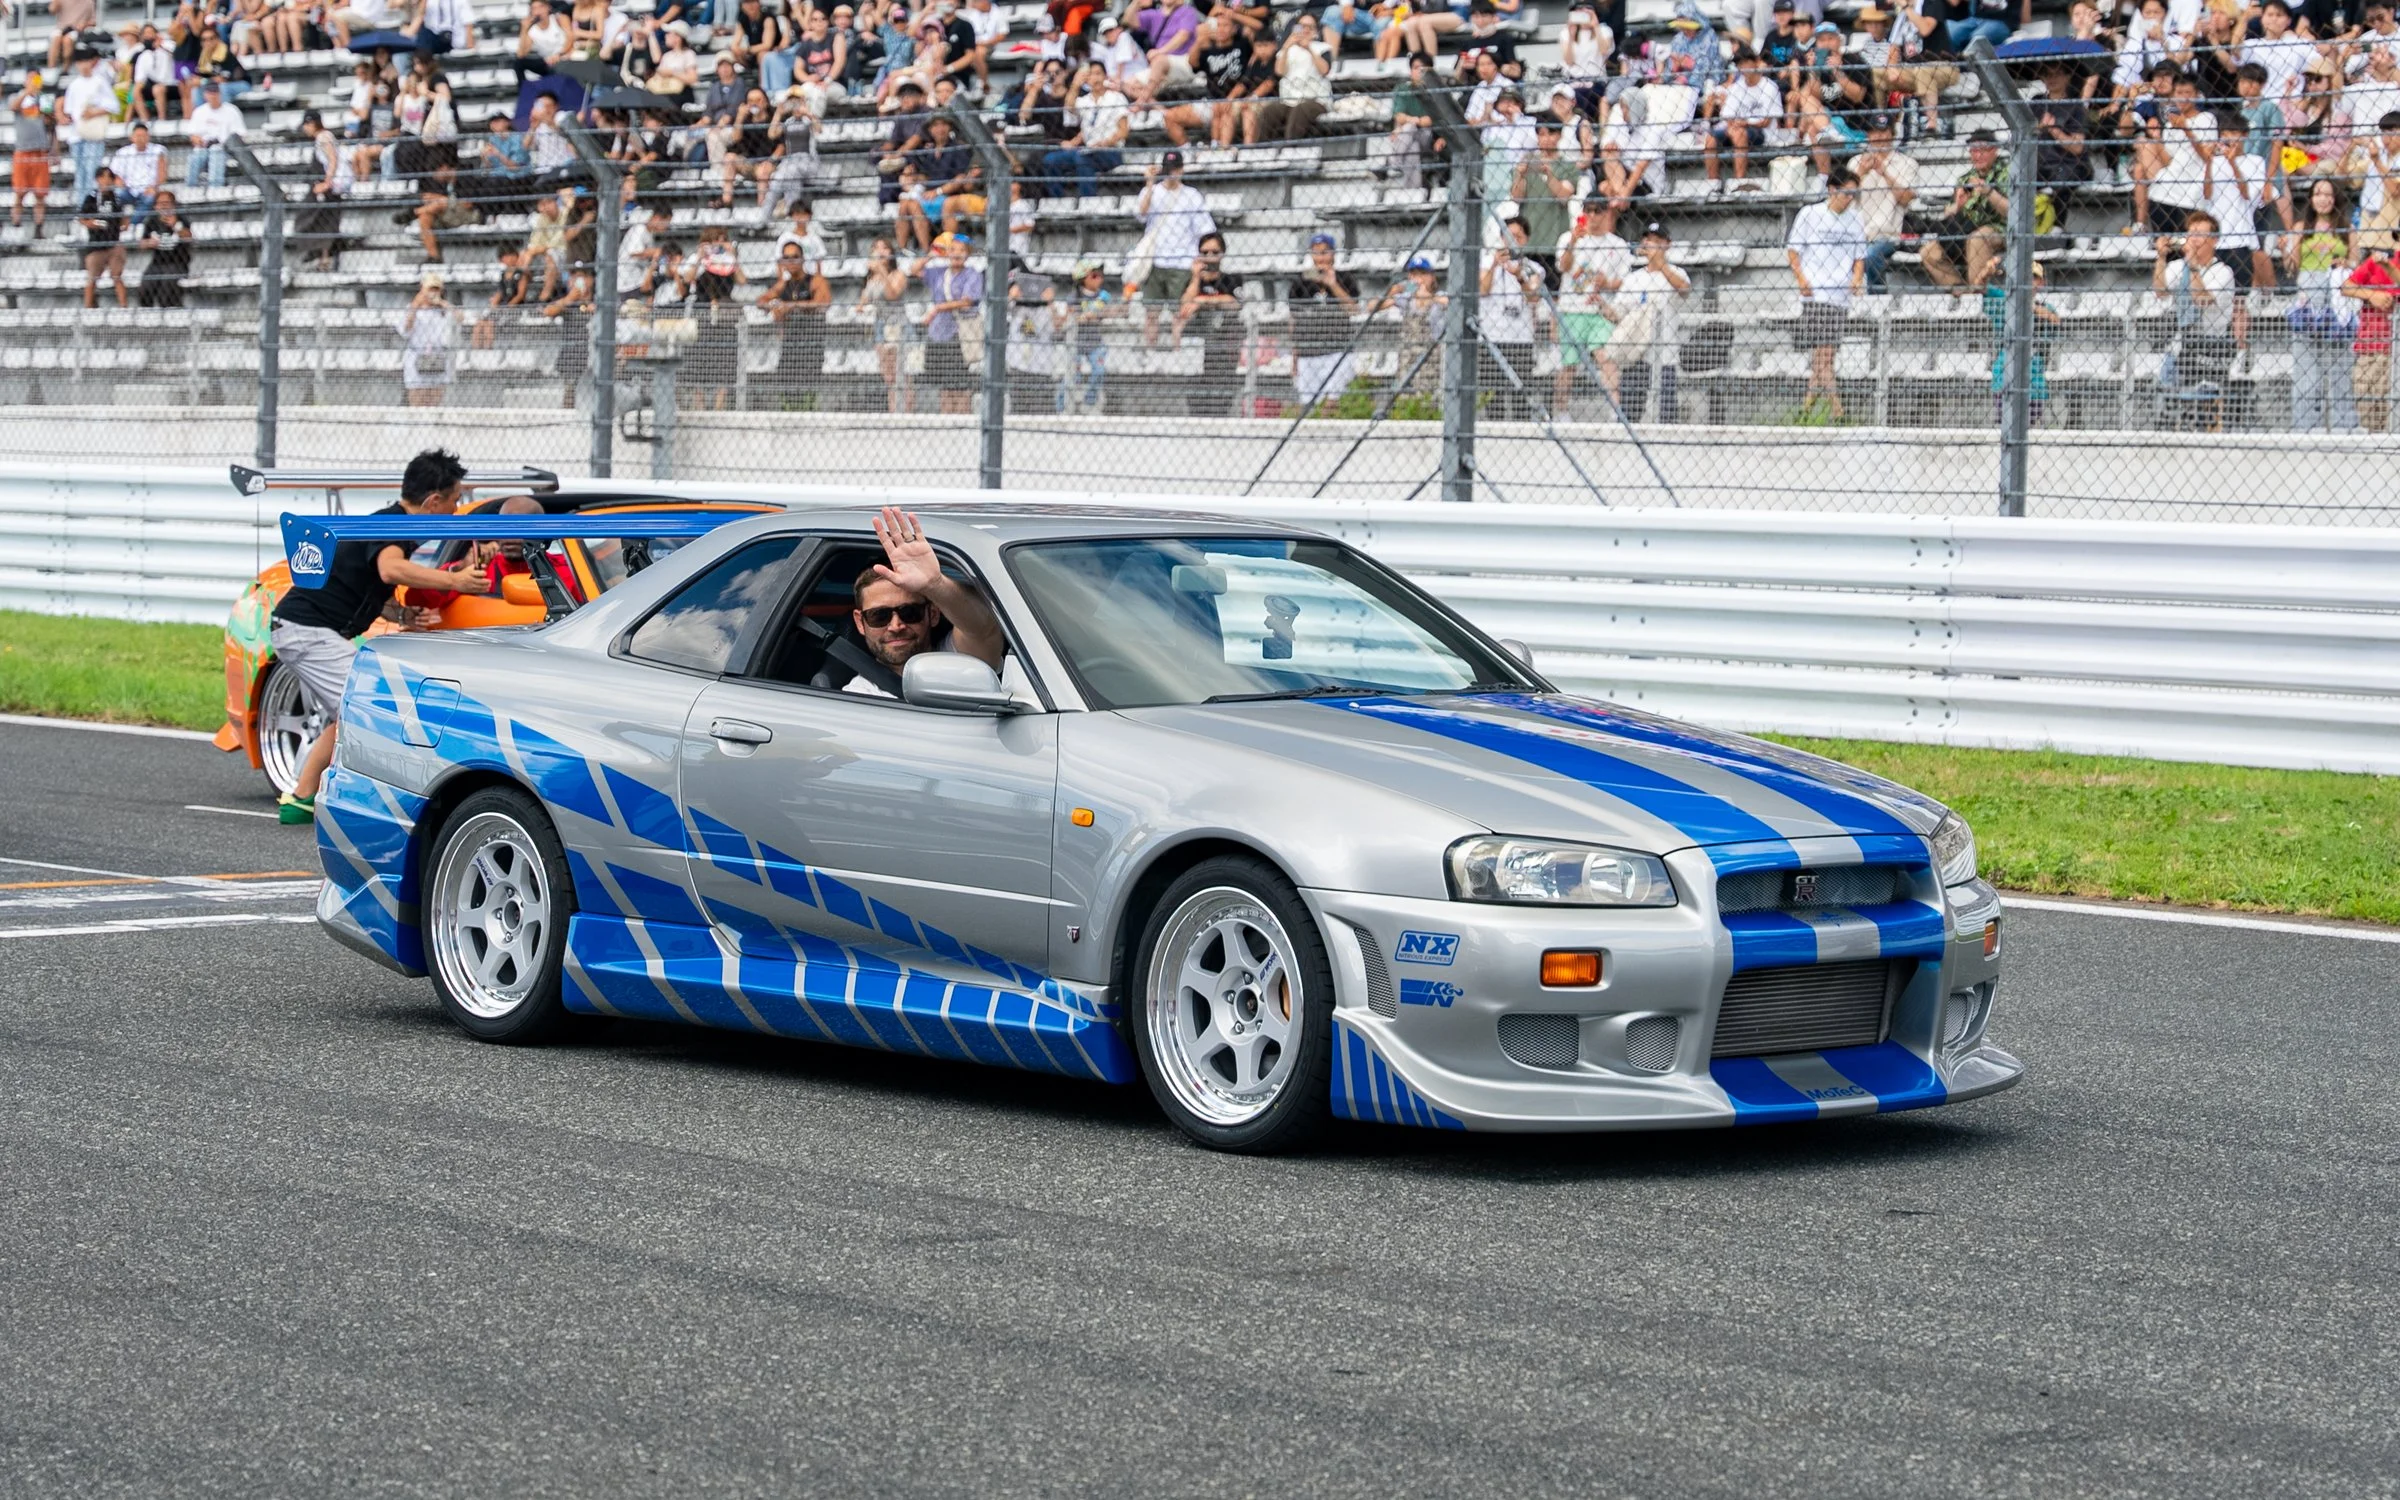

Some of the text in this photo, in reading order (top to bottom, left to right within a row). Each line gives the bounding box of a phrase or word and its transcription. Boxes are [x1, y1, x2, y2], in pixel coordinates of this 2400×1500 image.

[1795, 875, 1819, 884] GT
[1794, 885, 1816, 902] R
[1401, 934, 1455, 955] NX
[1398, 952, 1424, 961] NITROUS
[1423, 981, 1463, 1008] K&N
[1805, 1085, 1865, 1100] MoTeC
